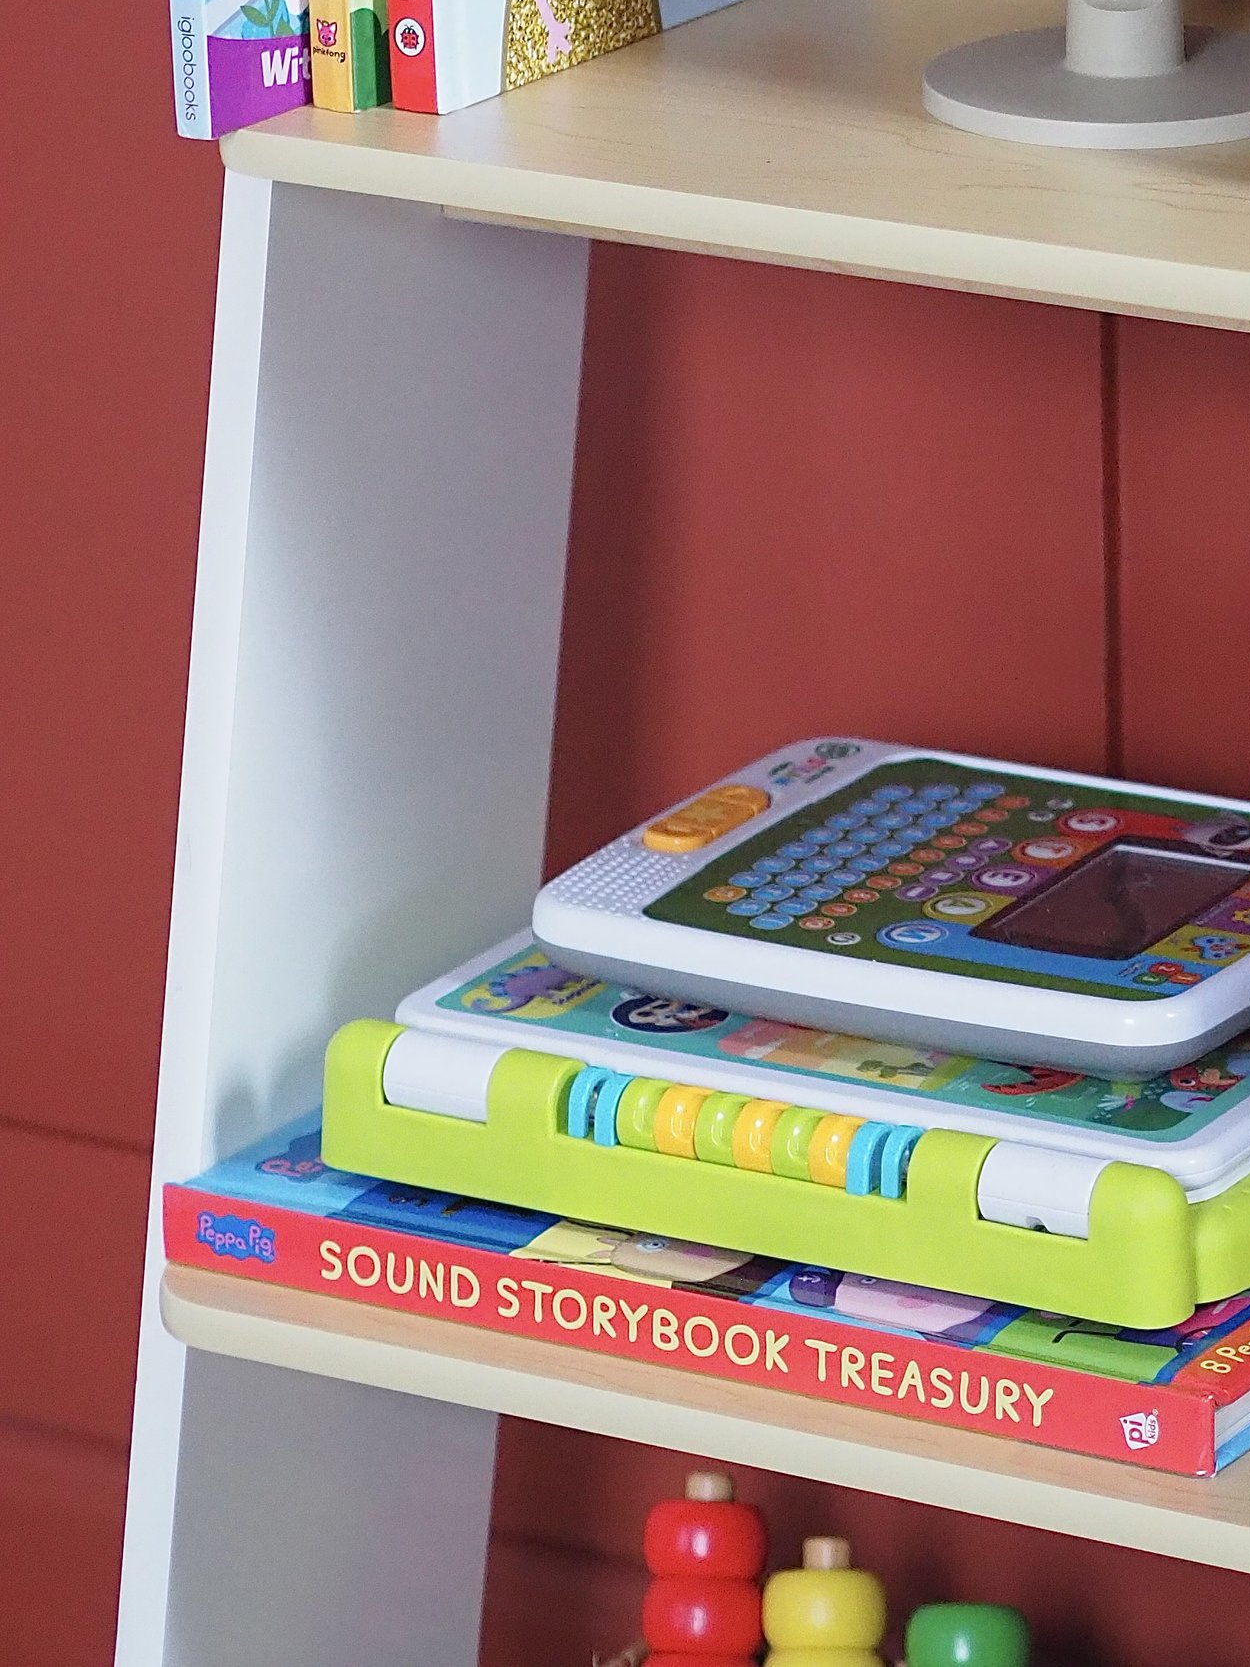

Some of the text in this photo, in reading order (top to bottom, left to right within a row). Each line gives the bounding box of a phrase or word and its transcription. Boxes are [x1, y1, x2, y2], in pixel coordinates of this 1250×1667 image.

[313, 46, 346, 63] pinkfong
[178, 16, 199, 121] igloobooks
[199, 1214, 275, 1259] Peppa Pig
[319, 1240, 1055, 1428] SOUND STORYBOOK TREASURY
[1201, 1358, 1232, 1376] 8
[1123, 1419, 1150, 1444] pi
[1148, 1419, 1156, 1439] kids
